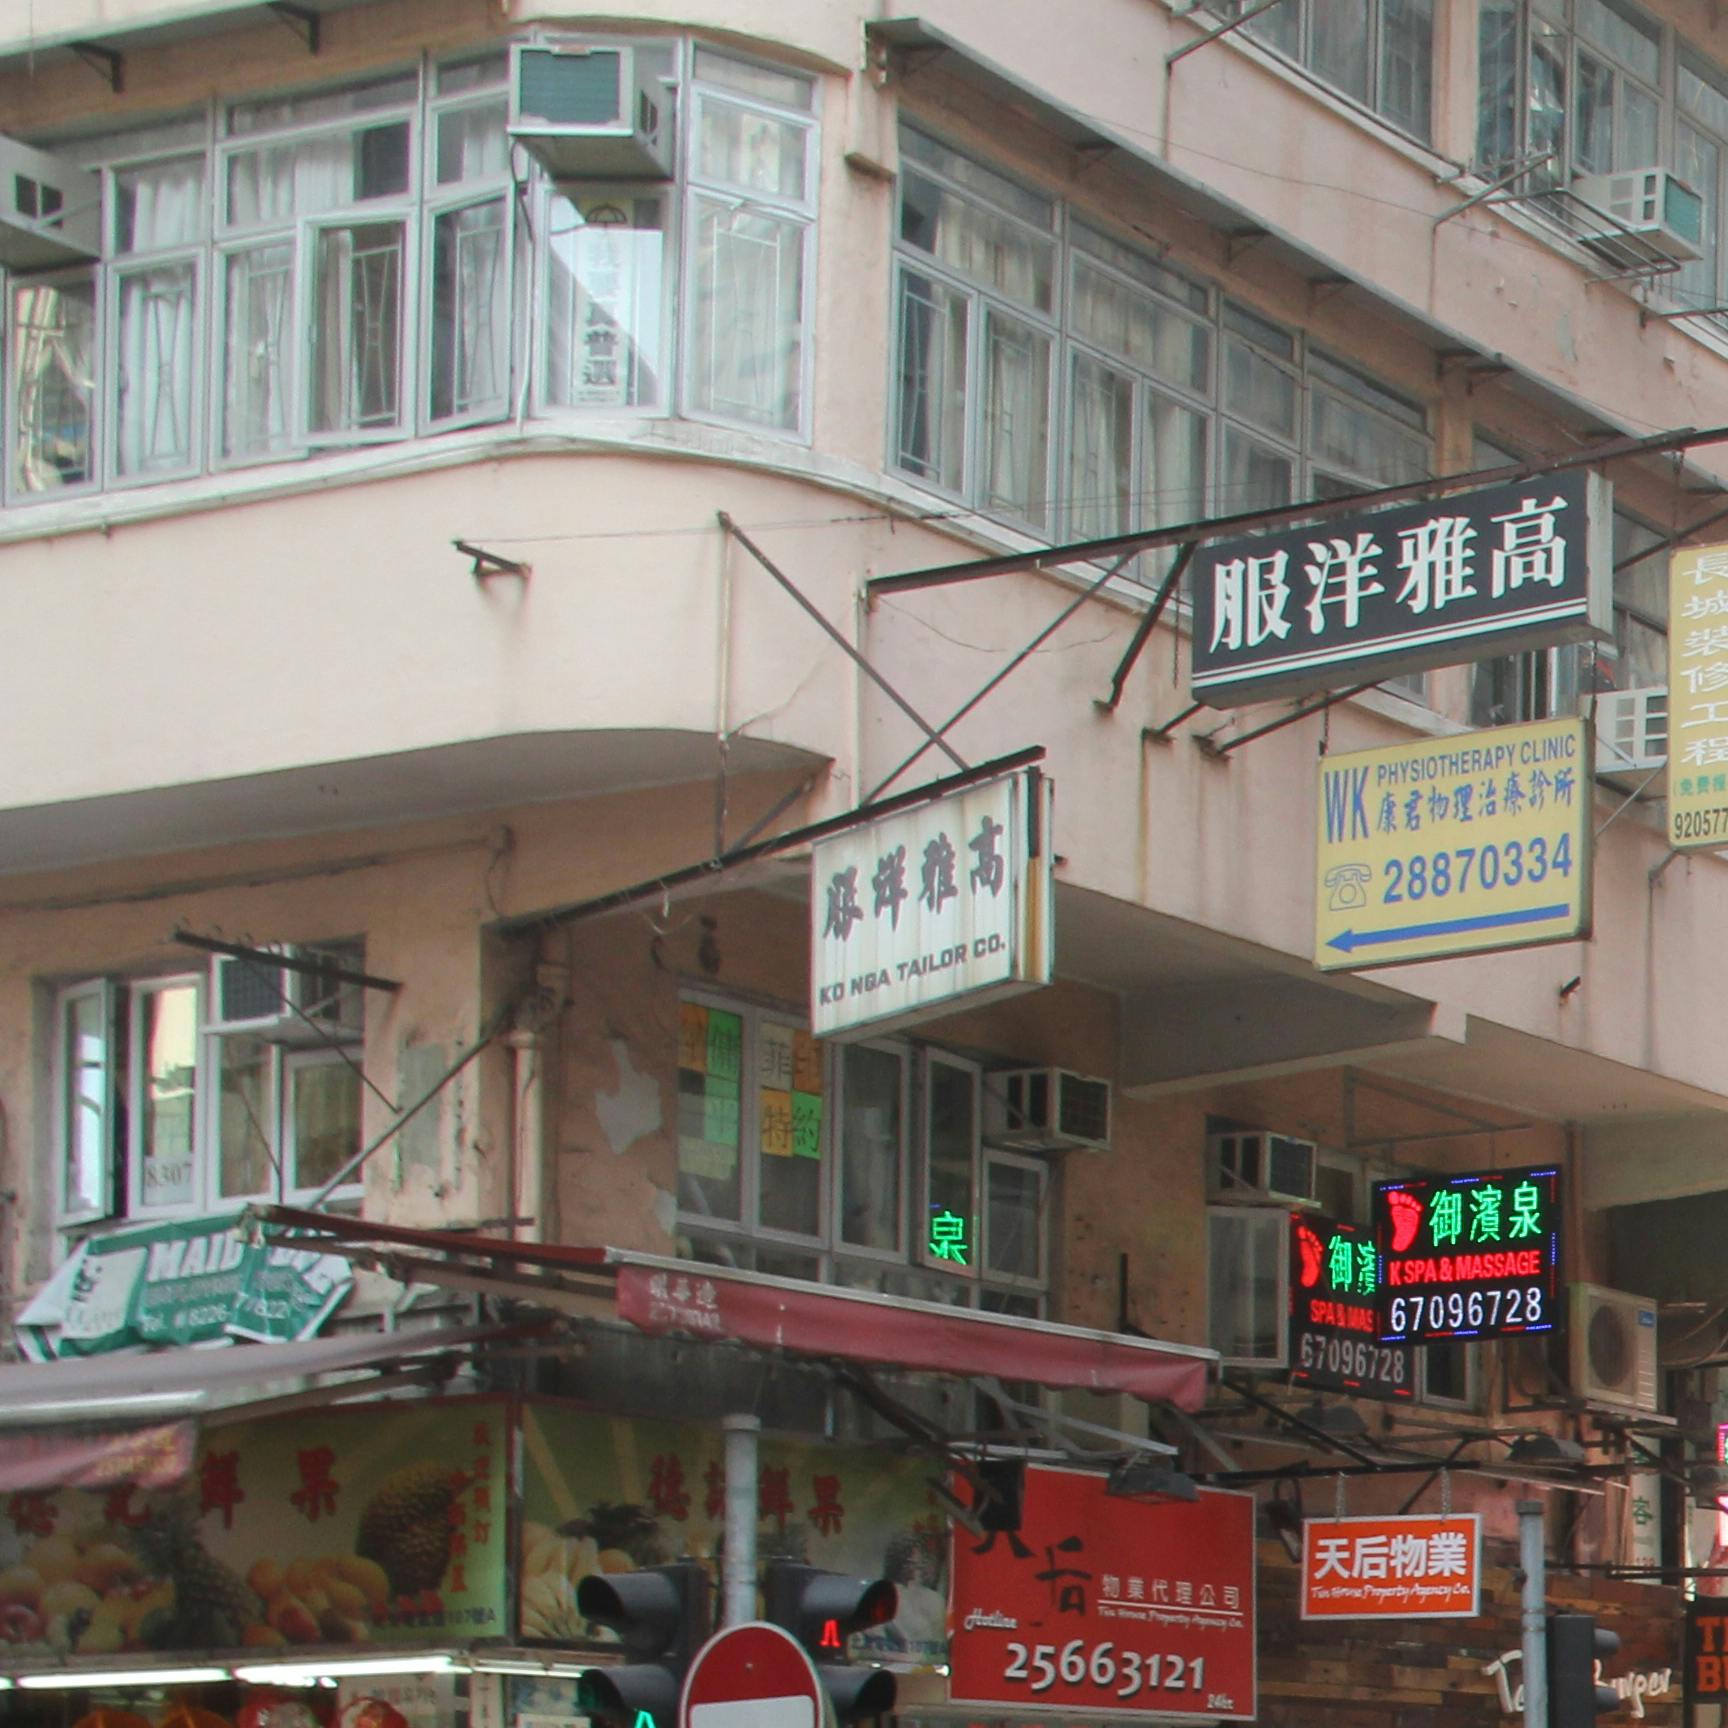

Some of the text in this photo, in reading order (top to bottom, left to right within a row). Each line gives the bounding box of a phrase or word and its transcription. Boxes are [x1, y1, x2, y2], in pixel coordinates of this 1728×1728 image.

[1377, 733, 1576, 787] PHYSIOTHERAPY CLINIC
[1324, 765, 1370, 843] WK
[1382, 831, 1573, 904] 28870334
[896, 943, 969, 981] TAILOR
[972, 933, 1006, 959] CO.
[1429, 1180, 1542, 1247] 御濱泉
[1389, 1250, 1542, 1287] K SPA & MASSAGE
[1390, 1286, 1542, 1333] 67096728
[1300, 1332, 1405, 1384] 67096728
[1313, 1531, 1468, 1580] 天后物業
[1101, 1573, 1241, 1610] 物業代理公司
[1004, 1639, 1205, 1697] 25663121
